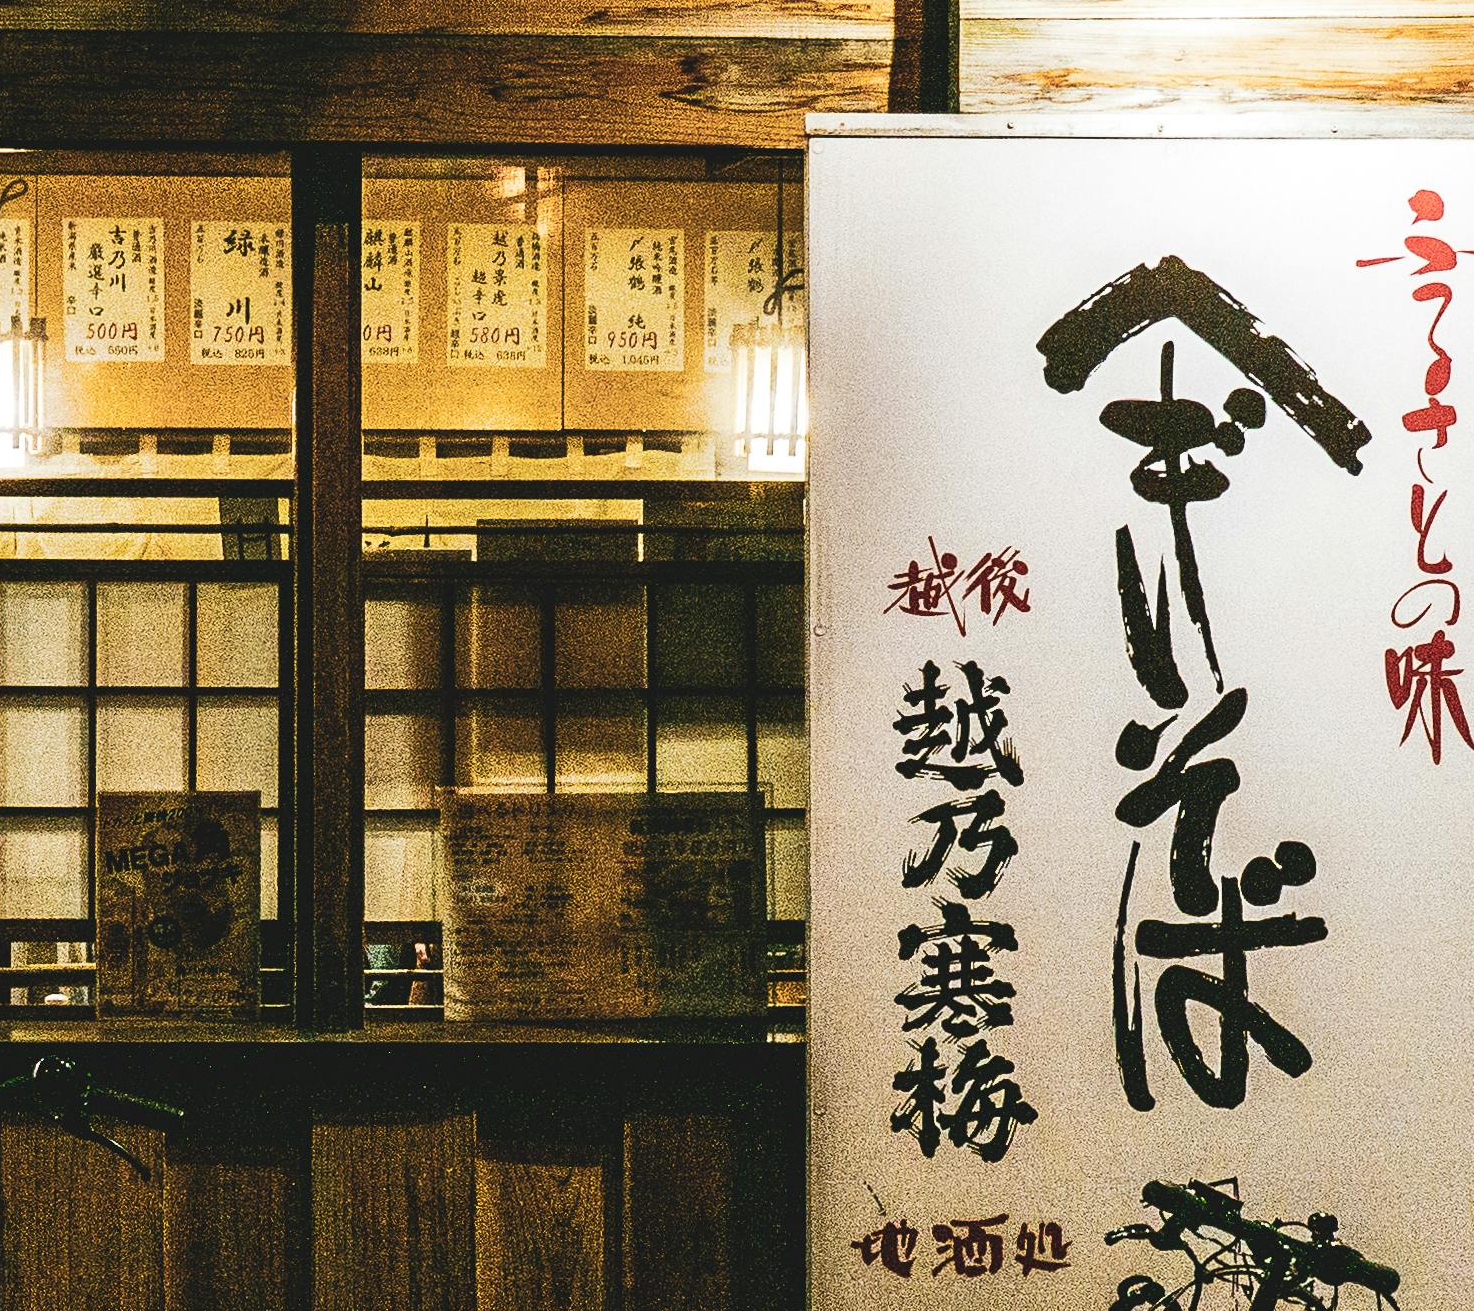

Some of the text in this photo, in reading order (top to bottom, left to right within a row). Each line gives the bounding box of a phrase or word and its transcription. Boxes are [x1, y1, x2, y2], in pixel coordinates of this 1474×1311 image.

[108, 224, 126, 293] 吉乃川
[223, 229, 255, 325] 緑川
[491, 230, 508, 306] 越乃景虎
[86, 322, 138, 341] 500円
[213, 326, 265, 344] 750円
[469, 326, 520, 345] 580円
[607, 331, 657, 350] 950円
[884, 536, 1031, 636] 越後
[1035, 254, 1372, 1113] へぎそば
[891, 660, 1037, 1162] 越乃寒梅
[850, 1212, 1073, 1279] 地酒処
